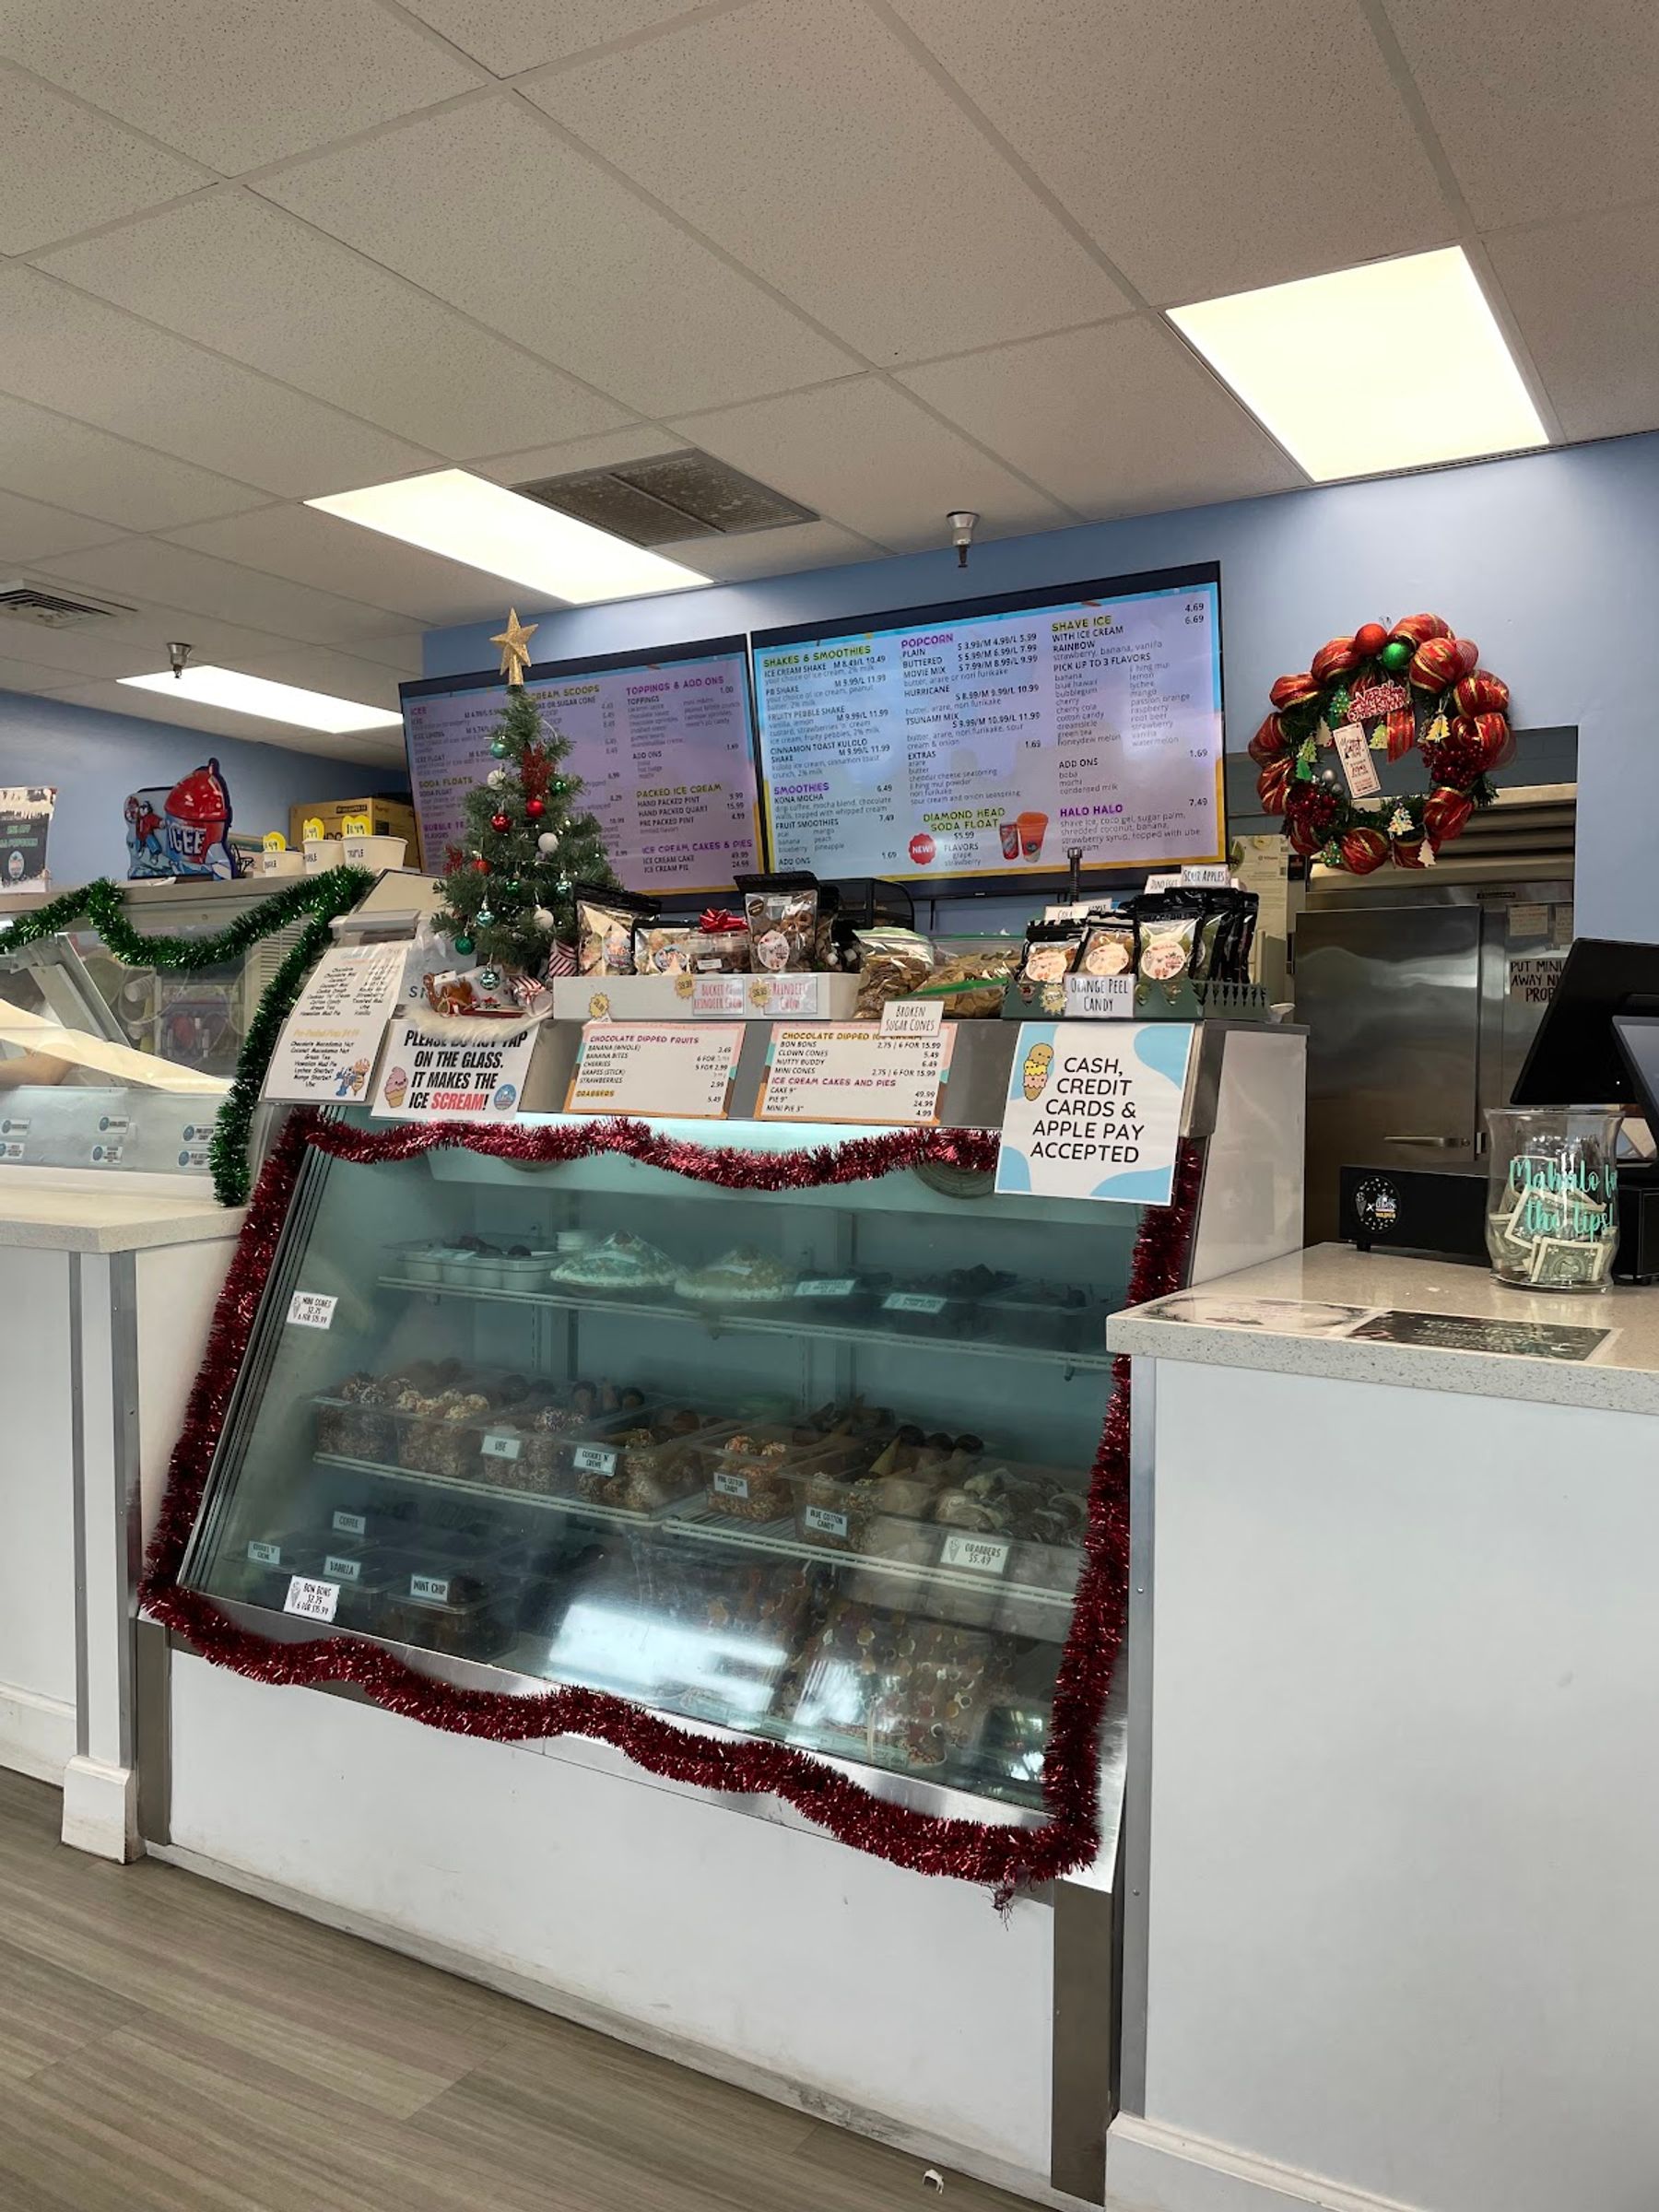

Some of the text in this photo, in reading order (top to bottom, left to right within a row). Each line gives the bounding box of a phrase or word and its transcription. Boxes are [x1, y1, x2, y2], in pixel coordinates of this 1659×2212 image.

[1184, 603, 1205, 613] 4.69
[1052, 616, 1112, 632] SHAVE ICE
[1184, 615, 1205, 625] 6.69
[1053, 626, 1124, 642] WITH ICE CREAM
[901, 634, 954, 648] POPCORN
[1053, 641, 1095, 653] RAINBOW
[764, 655, 799, 667] SHAKES
[813, 646, 871, 660] SMOOTHIES
[902, 649, 926, 657] PLAIN
[903, 657, 943, 668] BUTTERED
[1053, 662, 1073, 672] PICK
[1076, 661, 1088, 669] UP
[1090, 659, 1101, 667] TO
[1112, 653, 1151, 665] FLAVORS
[776, 666, 802, 677] CREAM
[804, 664, 826, 673] SHAKE
[903, 666, 947, 678] MOVIE MIX
[626, 683, 670, 696] TOPPINGS
[705, 676, 724, 686] ONS
[904, 685, 950, 698] HURRICANE
[906, 714, 941, 725] TSUNAMI
[771, 744, 811, 754] CINNAMON
[908, 751, 936, 759] EXTRAS
[1059, 758, 1099, 769] ADD ONS
[636, 788, 670, 798] PACKED
[690, 784, 722, 794] CREAM
[774, 782, 830, 794] SMOOTHIES
[797, 794, 823, 802] MOCHA
[924, 807, 1006, 822] DIAMOND HEAD
[1060, 806, 1089, 817] HALO
[1093, 804, 1124, 815] HALO
[776, 821, 795, 830] FRUIT
[797, 818, 839, 828] SMOOTHIES
[931, 818, 999, 832] SODA FLOAT
[169, 822, 206, 853] ICEE
[1202, 870, 1225, 881] APPLES
[1511, 961, 1531, 972] PUT
[1071, 978, 1128, 994] ORANGE PEEL
[1512, 974, 1542, 986] AWAY
[1084, 996, 1113, 1011] CANDY
[896, 1006, 926, 1018] BROKEN
[886, 1019, 935, 1031] SUGAR CONES
[637, 1035, 667, 1043] DIPPED
[837, 1032, 869, 1041] DIPPED
[414, 1051, 503, 1068] ON THE GLASS.
[1064, 1057, 1124, 1077] CASH,
[410, 1071, 498, 1089] IT MAKES THE
[788, 1077, 818, 1086] CREAM
[1057, 1078, 1133, 1096] CREDIT
[408, 1092, 489, 1111] ICE SCREAM!
[1045, 1100, 1136, 1118] CARDS &
[1032, 1120, 1145, 1141] APPLE PAY
[1030, 1142, 1139, 1163] ACCEPTED
